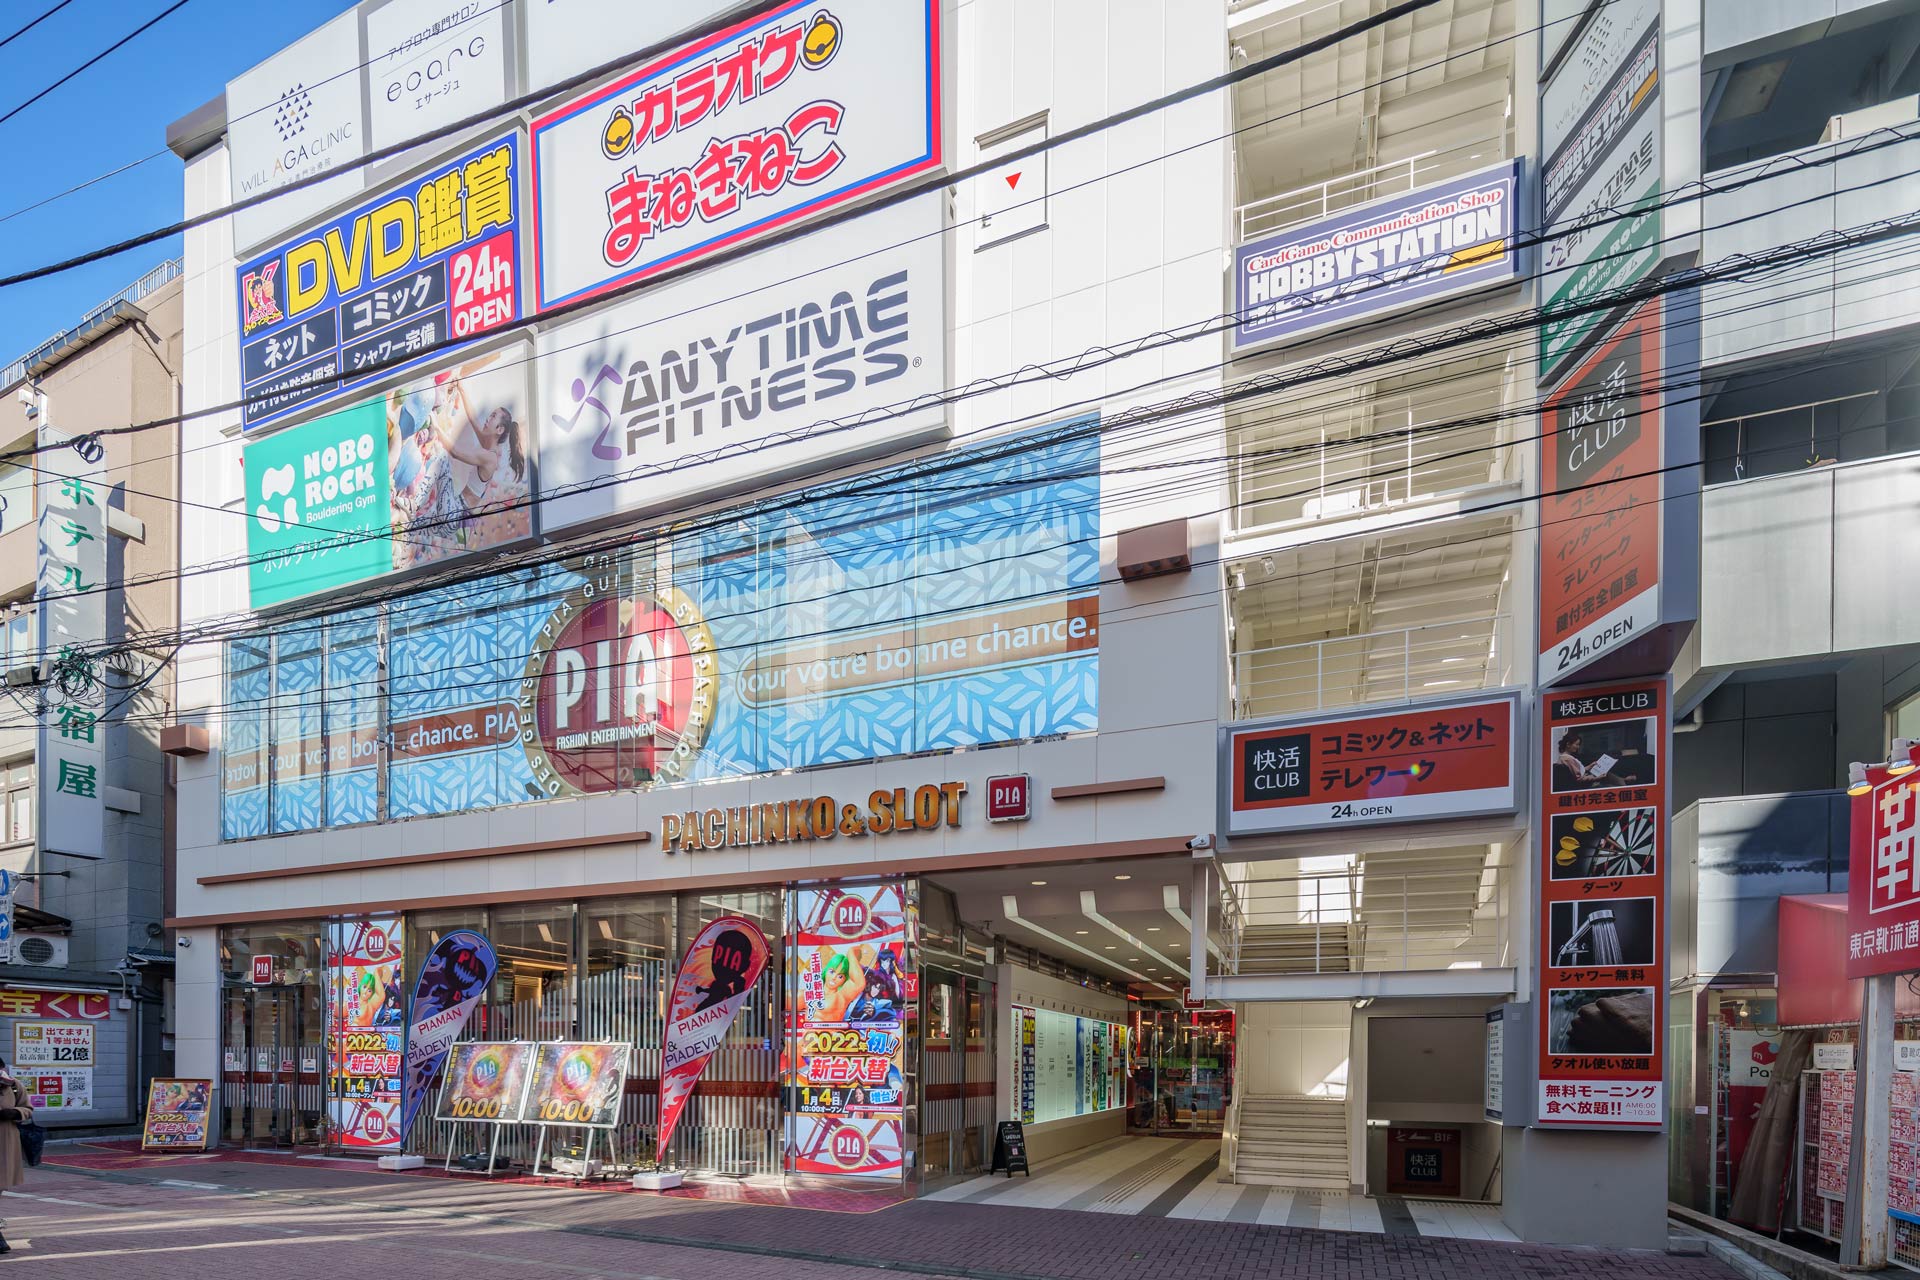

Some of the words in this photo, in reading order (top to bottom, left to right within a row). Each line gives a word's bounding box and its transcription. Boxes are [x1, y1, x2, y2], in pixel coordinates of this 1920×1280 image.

[415, 80, 460, 109] エサージュ
[633, 25, 804, 150] カラオケ
[241, 169, 268, 193] WILL
[273, 145, 308, 177] AGA
[311, 122, 352, 156] CLINIC
[603, 102, 843, 264] まねきねこ
[286, 144, 513, 318] DVD鑑賞
[1249, 240, 1329, 272] CardGame
[1333, 202, 1457, 246] Communication
[1460, 189, 1502, 209] Shop
[1249, 204, 1502, 305] HOBBYSTATION
[453, 244, 511, 309] 24h
[353, 274, 432, 331] コミック
[454, 293, 512, 336] OPEN
[264, 323, 316, 369] ネット
[353, 326, 436, 370] シャワー完備
[620, 269, 908, 415] ANYTIME
[626, 330, 909, 457] FITNESS
[1567, 360, 1627, 441] 快活
[1568, 407, 1627, 472] CLUB
[304, 434, 374, 479] NOBO
[305, 462, 376, 508] ROCK
[1570, 464, 1625, 518] コミック
[306, 502, 353, 523] Bouldering
[355, 494, 376, 510] Gym
[60, 475, 97, 593] ホテル
[1557, 493, 1639, 561] インターネット
[1562, 535, 1632, 593] テレワーク
[1556, 567, 1639, 634] 鍵付完全個室
[796, 652, 867, 684] votre
[876, 640, 967, 672] bonne
[977, 615, 1096, 654] chance.
[1558, 638, 1590, 671] 24h
[1592, 616, 1633, 652] OPEN
[556, 633, 664, 729] PIA
[1560, 693, 1648, 717] 快活CLUB
[411, 722, 478, 749] chance.
[485, 711, 519, 737] PIA
[557, 728, 589, 750] FASHION
[592, 720, 657, 745] ENTERTAINMENT
[1321, 718, 1495, 755] コミック&ネット
[1253, 747, 1301, 772] 快活
[1254, 771, 1300, 790] CLUB
[1320, 759, 1436, 791] テレワーク
[995, 786, 1021, 805] PIA
[1558, 789, 1648, 808] 鍵付完全個室
[661, 795, 836, 854] PACHINKO
[838, 802, 868, 837] &
[868, 780, 968, 834] SLOT
[1330, 804, 1358, 818] 24h
[1360, 805, 1393, 817] OPEN
[1582, 881, 1623, 894] ダーツ
[839, 906, 863, 923] PIA
[368, 936, 383, 949] PIA
[1850, 920, 1919, 959] 東京靴流通
[256, 962, 269, 974] PIA
[713, 944, 742, 972] PIA
[1560, 968, 1645, 982] シャワー無料
[0, 990, 109, 1018] 宝くじ
[46, 1027, 90, 1036] 出てます!
[418, 1008, 462, 1035] PIAMAN
[678, 1004, 729, 1035] PIAMAN
[46, 1037, 90, 1045] 1等当せん
[53, 1047, 89, 1061] 12億
[665, 1034, 721, 1067] PIADEVIL
[668, 1041, 677, 1052] &
[351, 1054, 399, 1074] 新台入替
[476, 1060, 496, 1080] PIA
[566, 1060, 588, 1080] PIA
[810, 1057, 889, 1081] 新台入替
[1551, 1058, 1650, 1070] タオル使い放題
[1750, 1066, 1774, 1078] Pa
[1545, 1084, 1656, 1098] 無料モーニング
[452, 1097, 500, 1118] 10:00
[539, 1099, 593, 1122] 10:00
[801, 1105, 842, 1113] 10:00オープン
[1546, 1101, 1622, 1115] 食べ放題!!
[368, 1117, 383, 1131] PIA
[838, 1136, 860, 1153] PIA
[1410, 1154, 1437, 1166] 快活
[1410, 1167, 1437, 1176] CLUB
